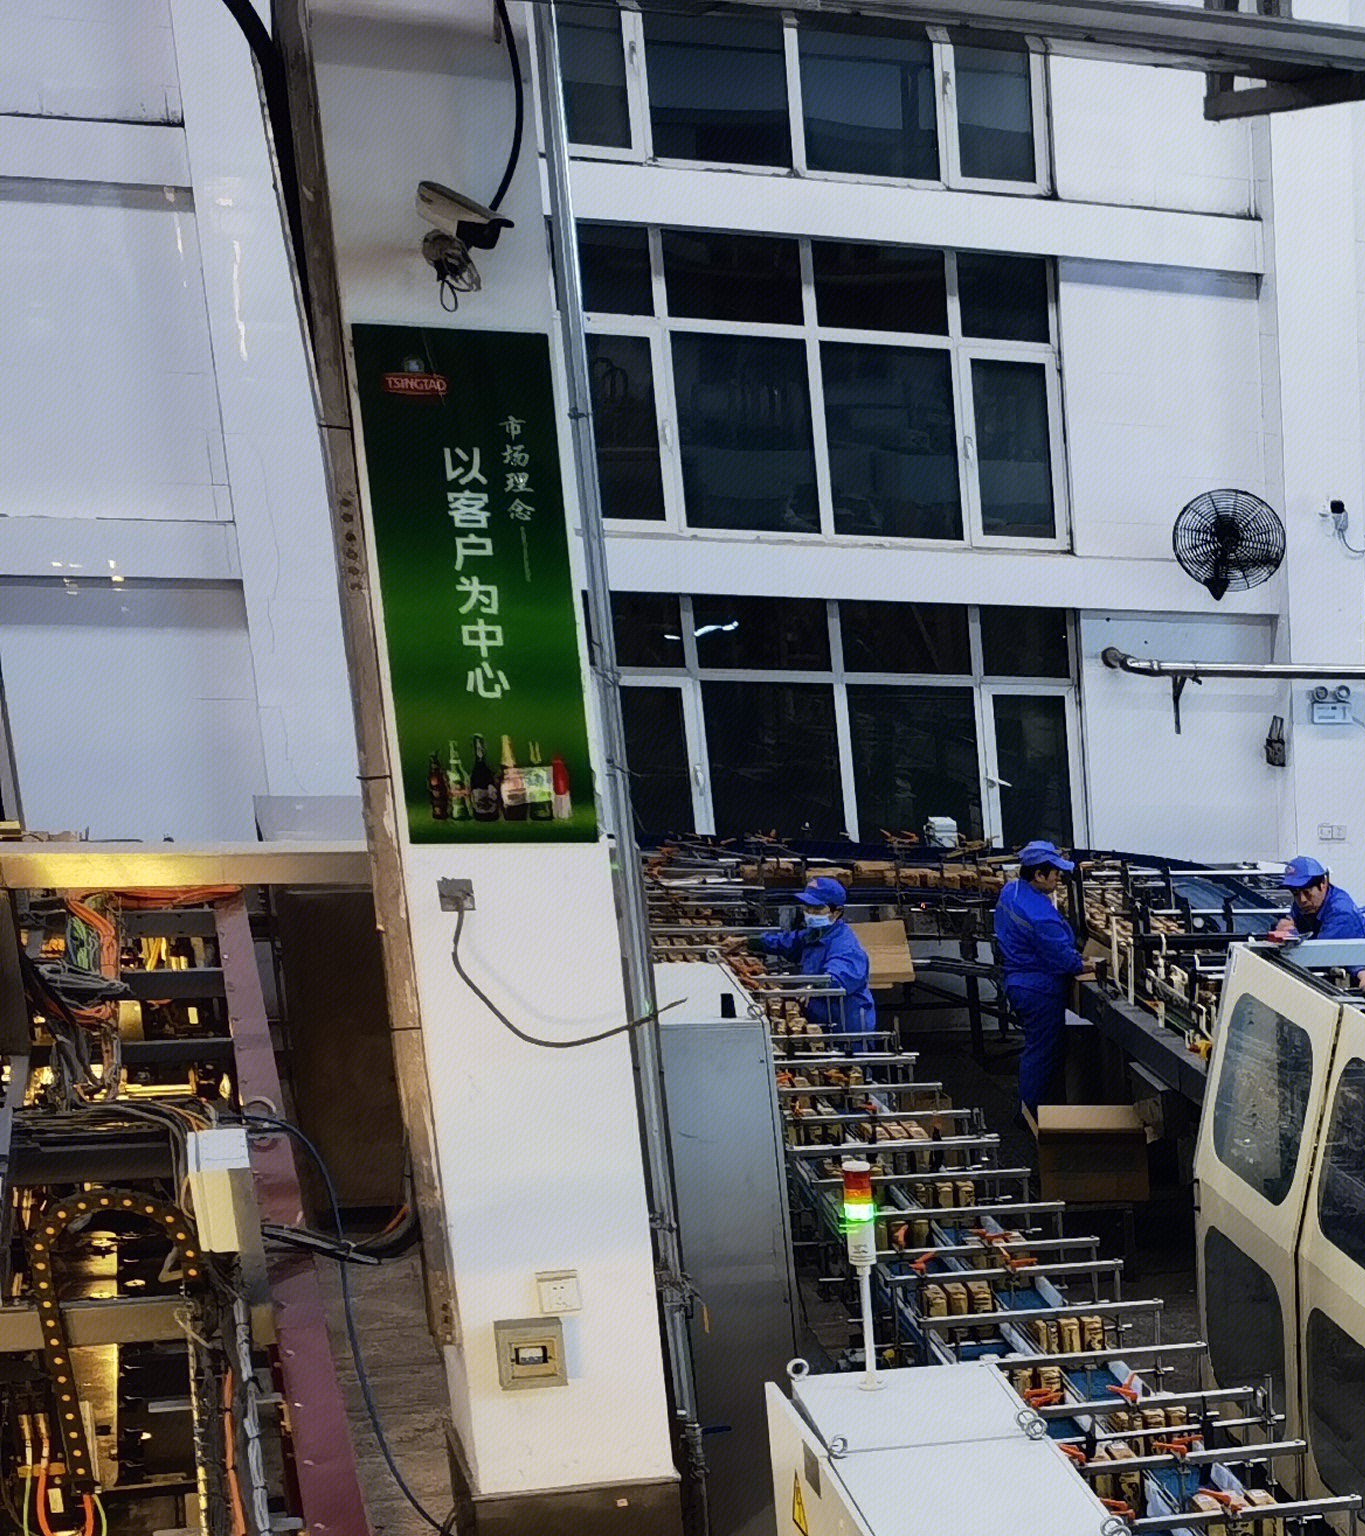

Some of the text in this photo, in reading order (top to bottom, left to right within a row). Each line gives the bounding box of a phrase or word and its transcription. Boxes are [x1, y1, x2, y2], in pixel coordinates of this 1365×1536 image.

[385, 376, 447, 392] TSINGTAO
[443, 446, 511, 700] 以客户为中心
